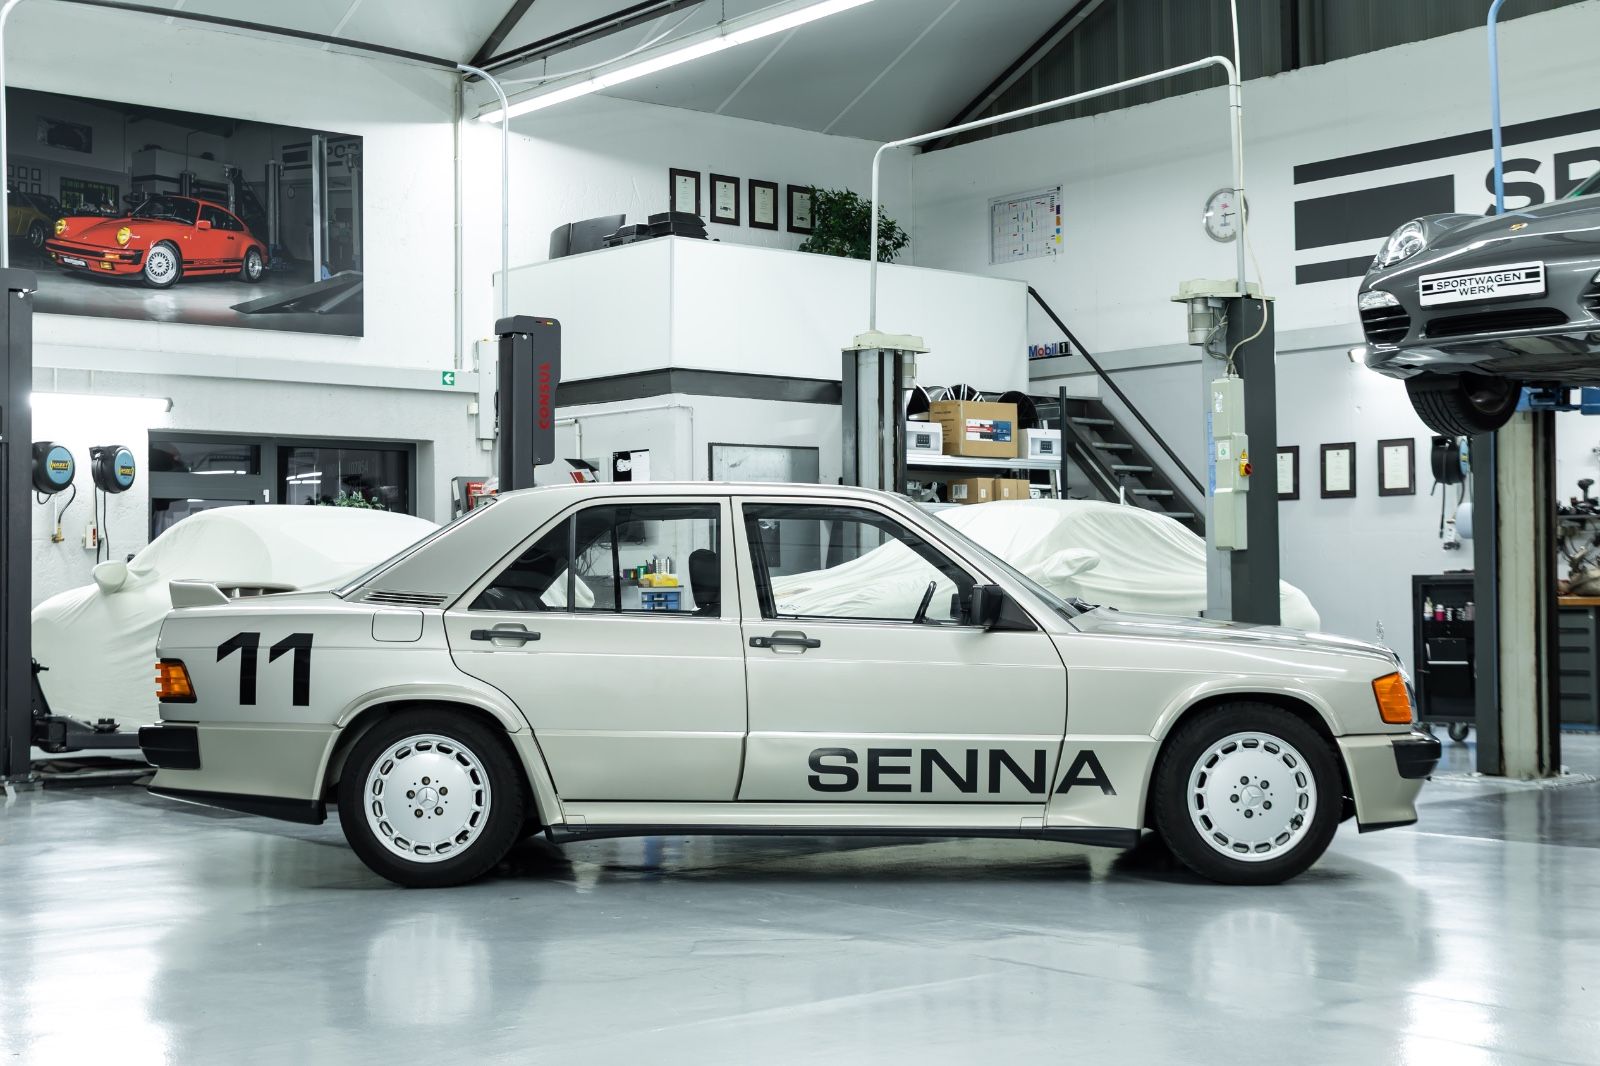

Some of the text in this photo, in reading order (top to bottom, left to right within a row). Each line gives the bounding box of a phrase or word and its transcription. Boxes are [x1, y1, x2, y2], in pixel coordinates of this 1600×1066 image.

[1436, 272, 1521, 290] SPORTWAGEN
[1458, 285, 1495, 296] WERK
[1028, 341, 1069, 358] Mobil 1
[538, 363, 551, 430] CONSUL
[216, 632, 314, 706] 11
[807, 747, 1117, 796] SENNA
